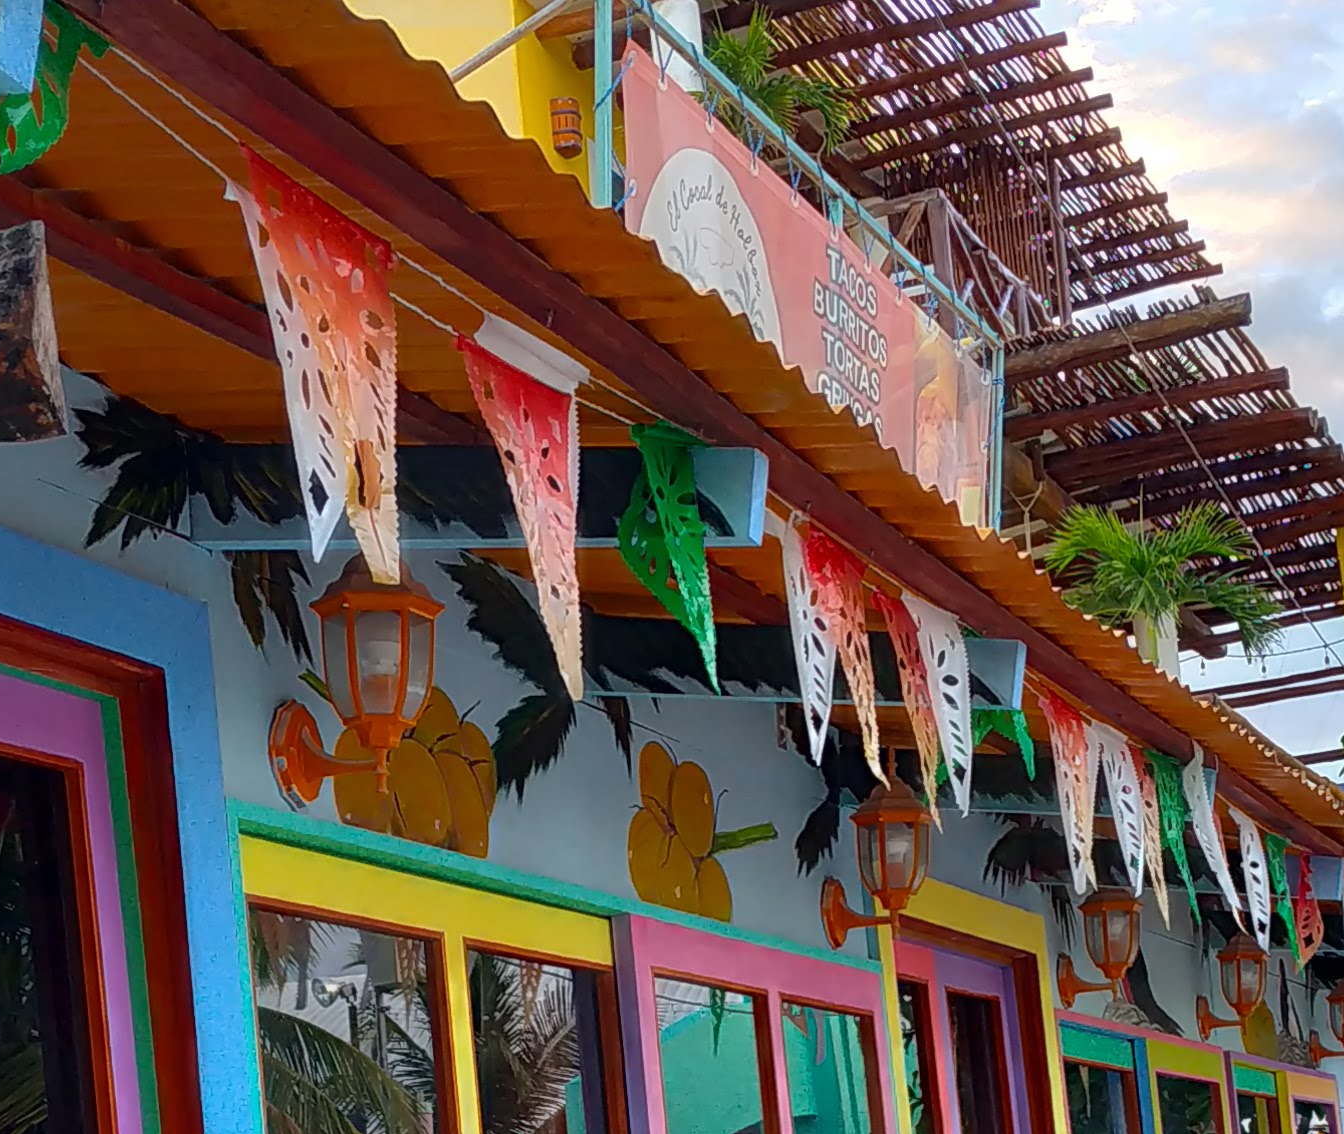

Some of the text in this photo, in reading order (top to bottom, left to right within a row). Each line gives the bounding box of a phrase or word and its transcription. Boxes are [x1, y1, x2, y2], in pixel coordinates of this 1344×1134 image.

[666, 189, 681, 233] El
[715, 185, 728, 215] de
[826, 246, 878, 318] TACOS
[813, 280, 888, 369] BURRITOS
[822, 329, 881, 403] TORTAS
